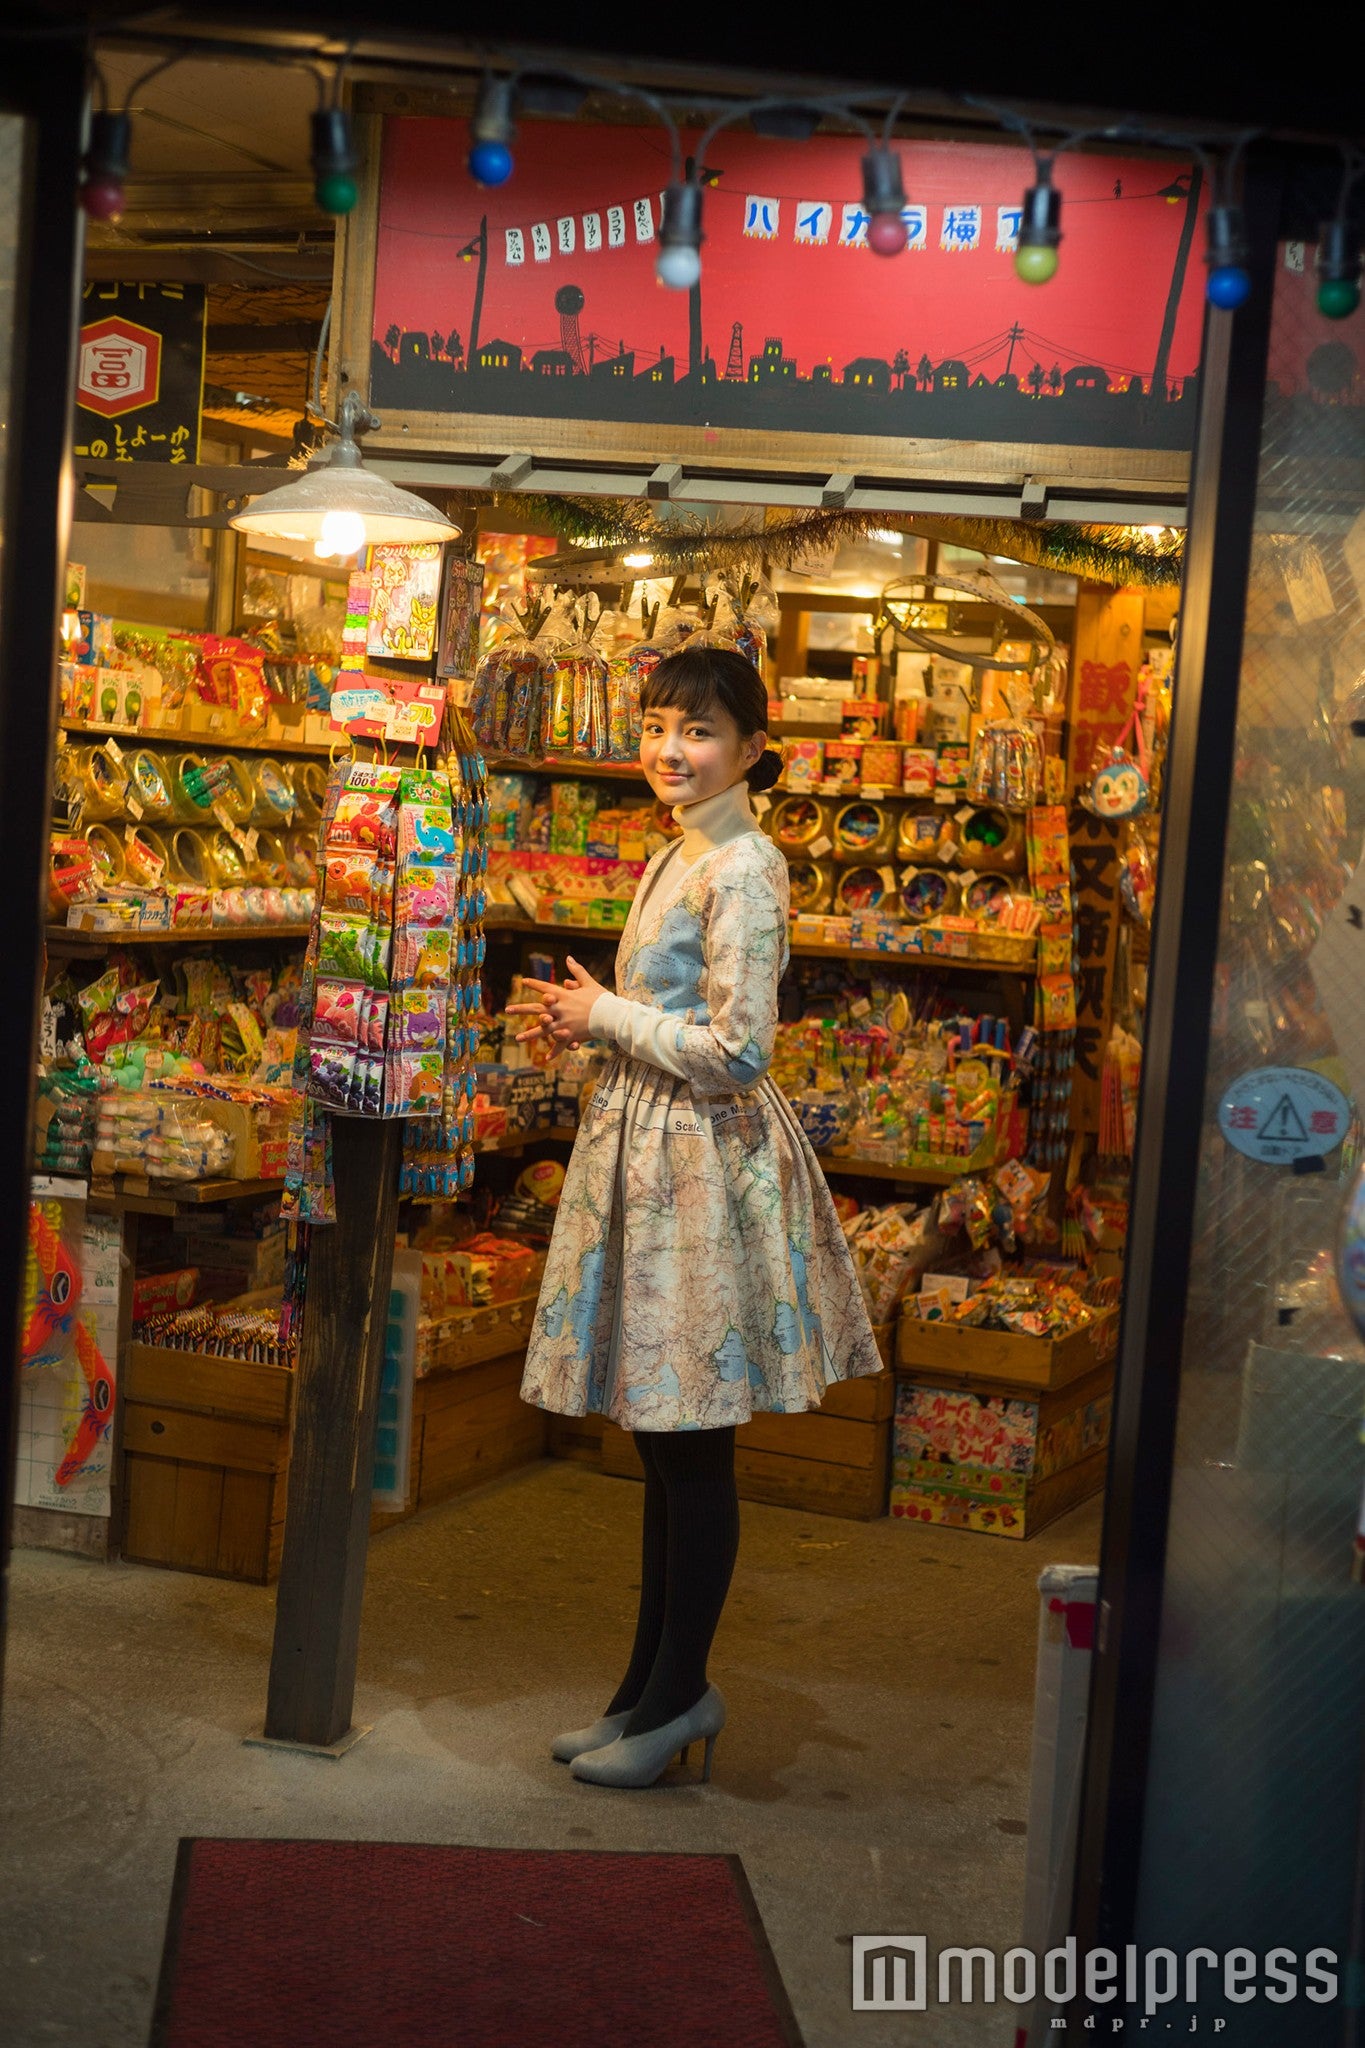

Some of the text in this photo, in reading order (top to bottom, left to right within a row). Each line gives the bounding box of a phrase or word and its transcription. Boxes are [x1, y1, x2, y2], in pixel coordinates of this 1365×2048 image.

[610, 209, 622, 242] ココア
[350, 776, 369, 787] 100
[330, 829, 352, 842] 100
[345, 896, 366, 909] 100
[319, 959, 339, 971] 100
[312, 1021, 333, 1035] 100
